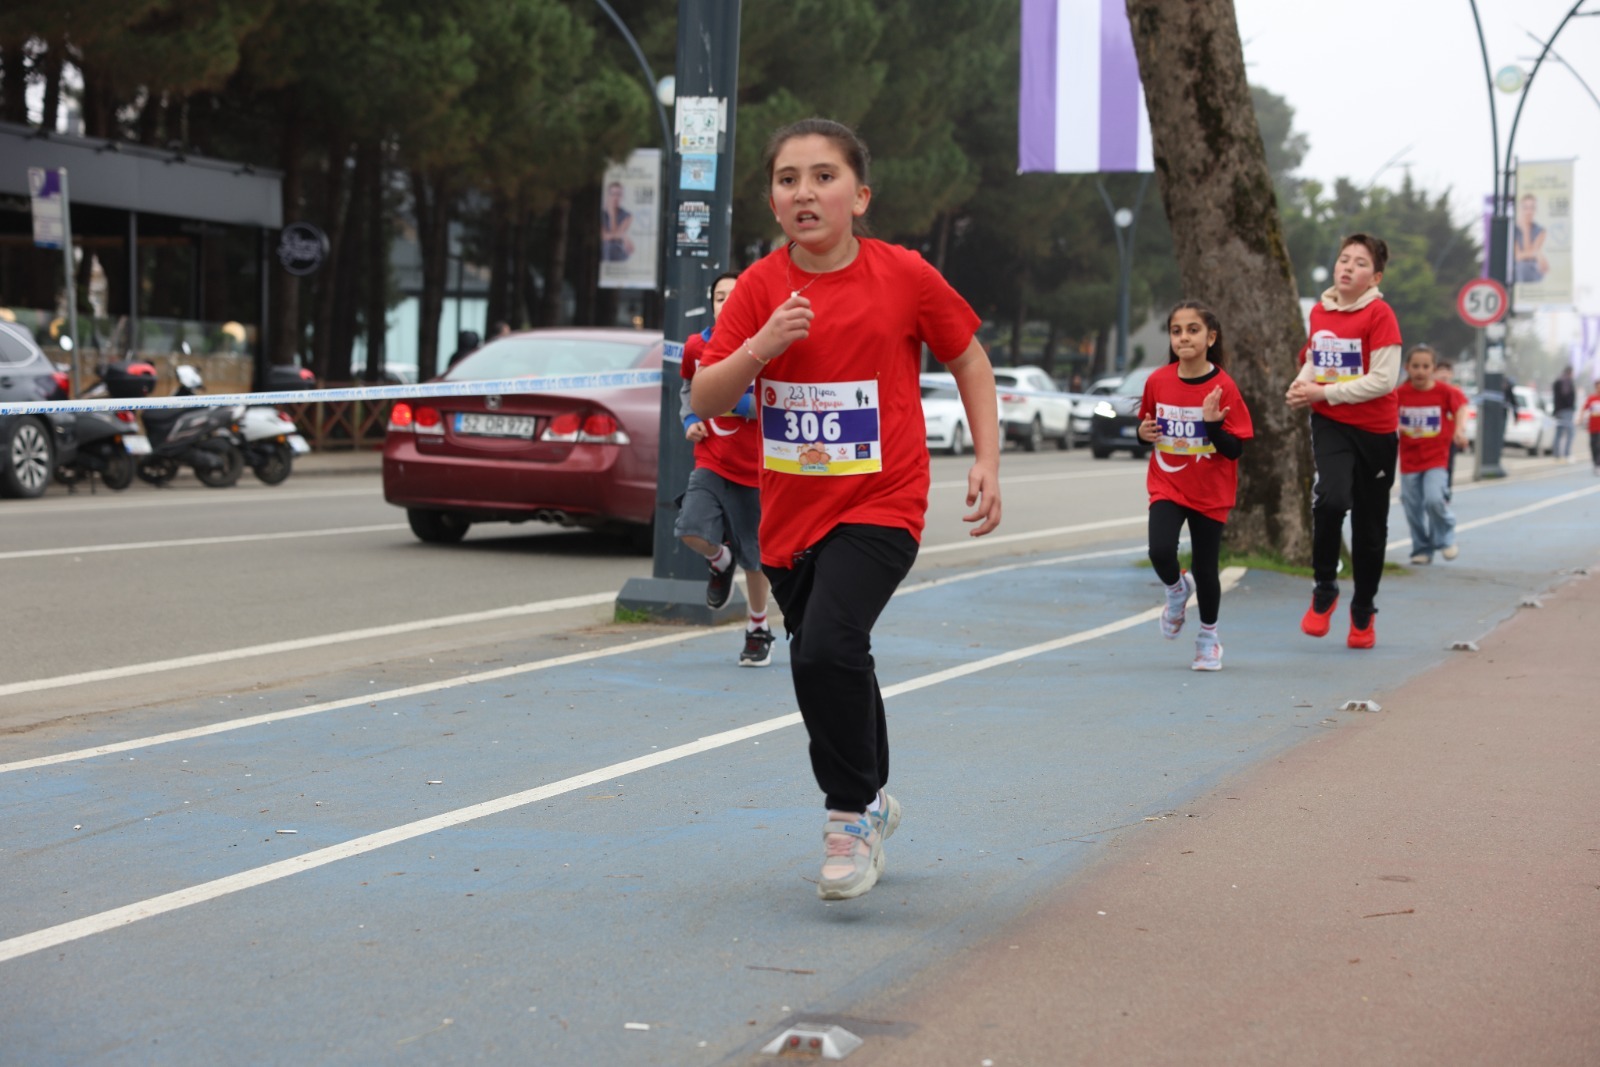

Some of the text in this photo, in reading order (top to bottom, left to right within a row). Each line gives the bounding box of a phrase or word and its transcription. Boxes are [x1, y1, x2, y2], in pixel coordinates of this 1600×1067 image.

[1468, 291, 1499, 314] 50
[1319, 352, 1343, 367] 353
[788, 386, 805, 400] 23
[784, 411, 841, 442] 306
[1166, 421, 1195, 437] 300
